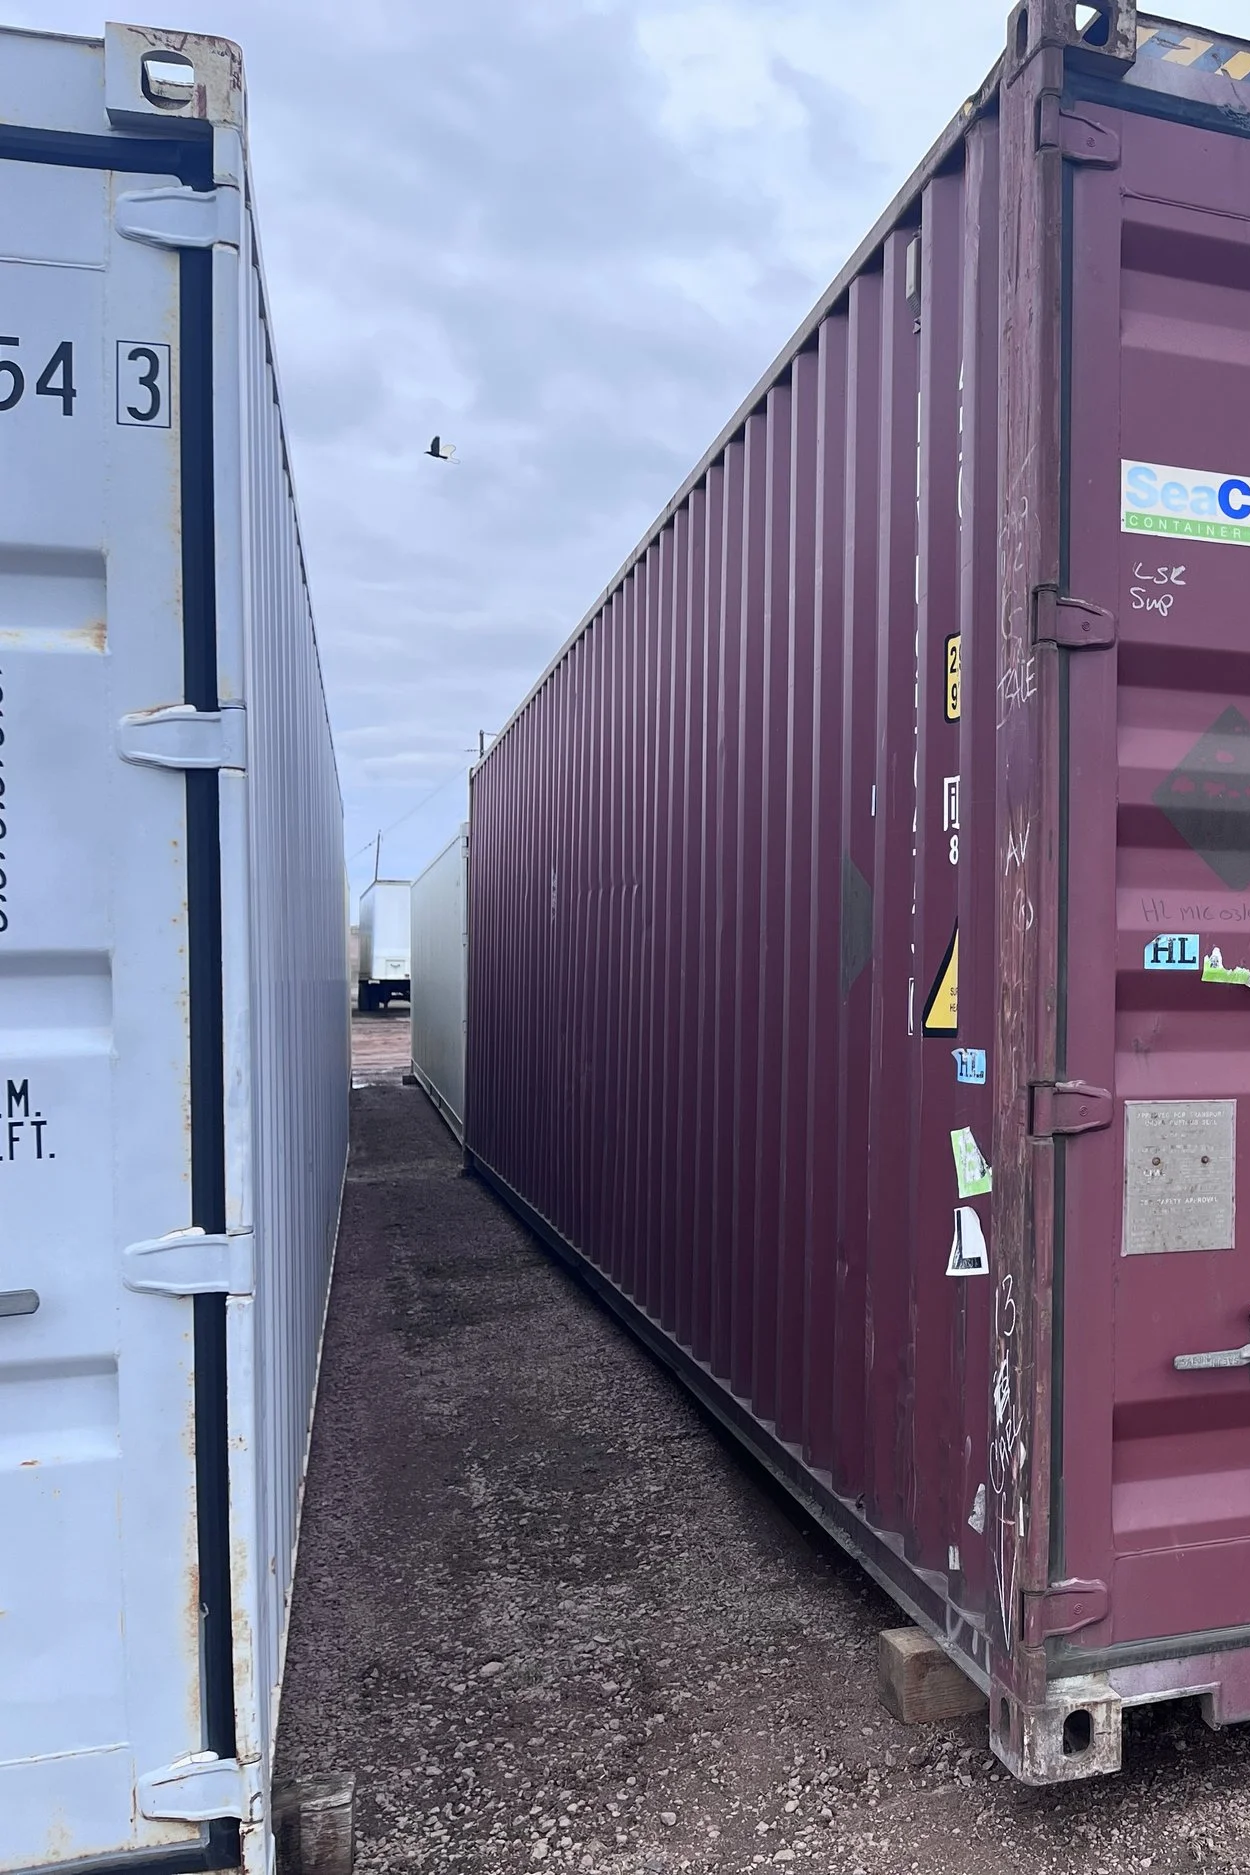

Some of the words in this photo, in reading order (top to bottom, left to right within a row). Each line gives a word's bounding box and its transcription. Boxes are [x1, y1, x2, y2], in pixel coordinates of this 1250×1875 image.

[127, 347, 161, 421] 3
[1129, 515, 1241, 539] CONTAINER
[1151, 937, 1197, 964] HL
